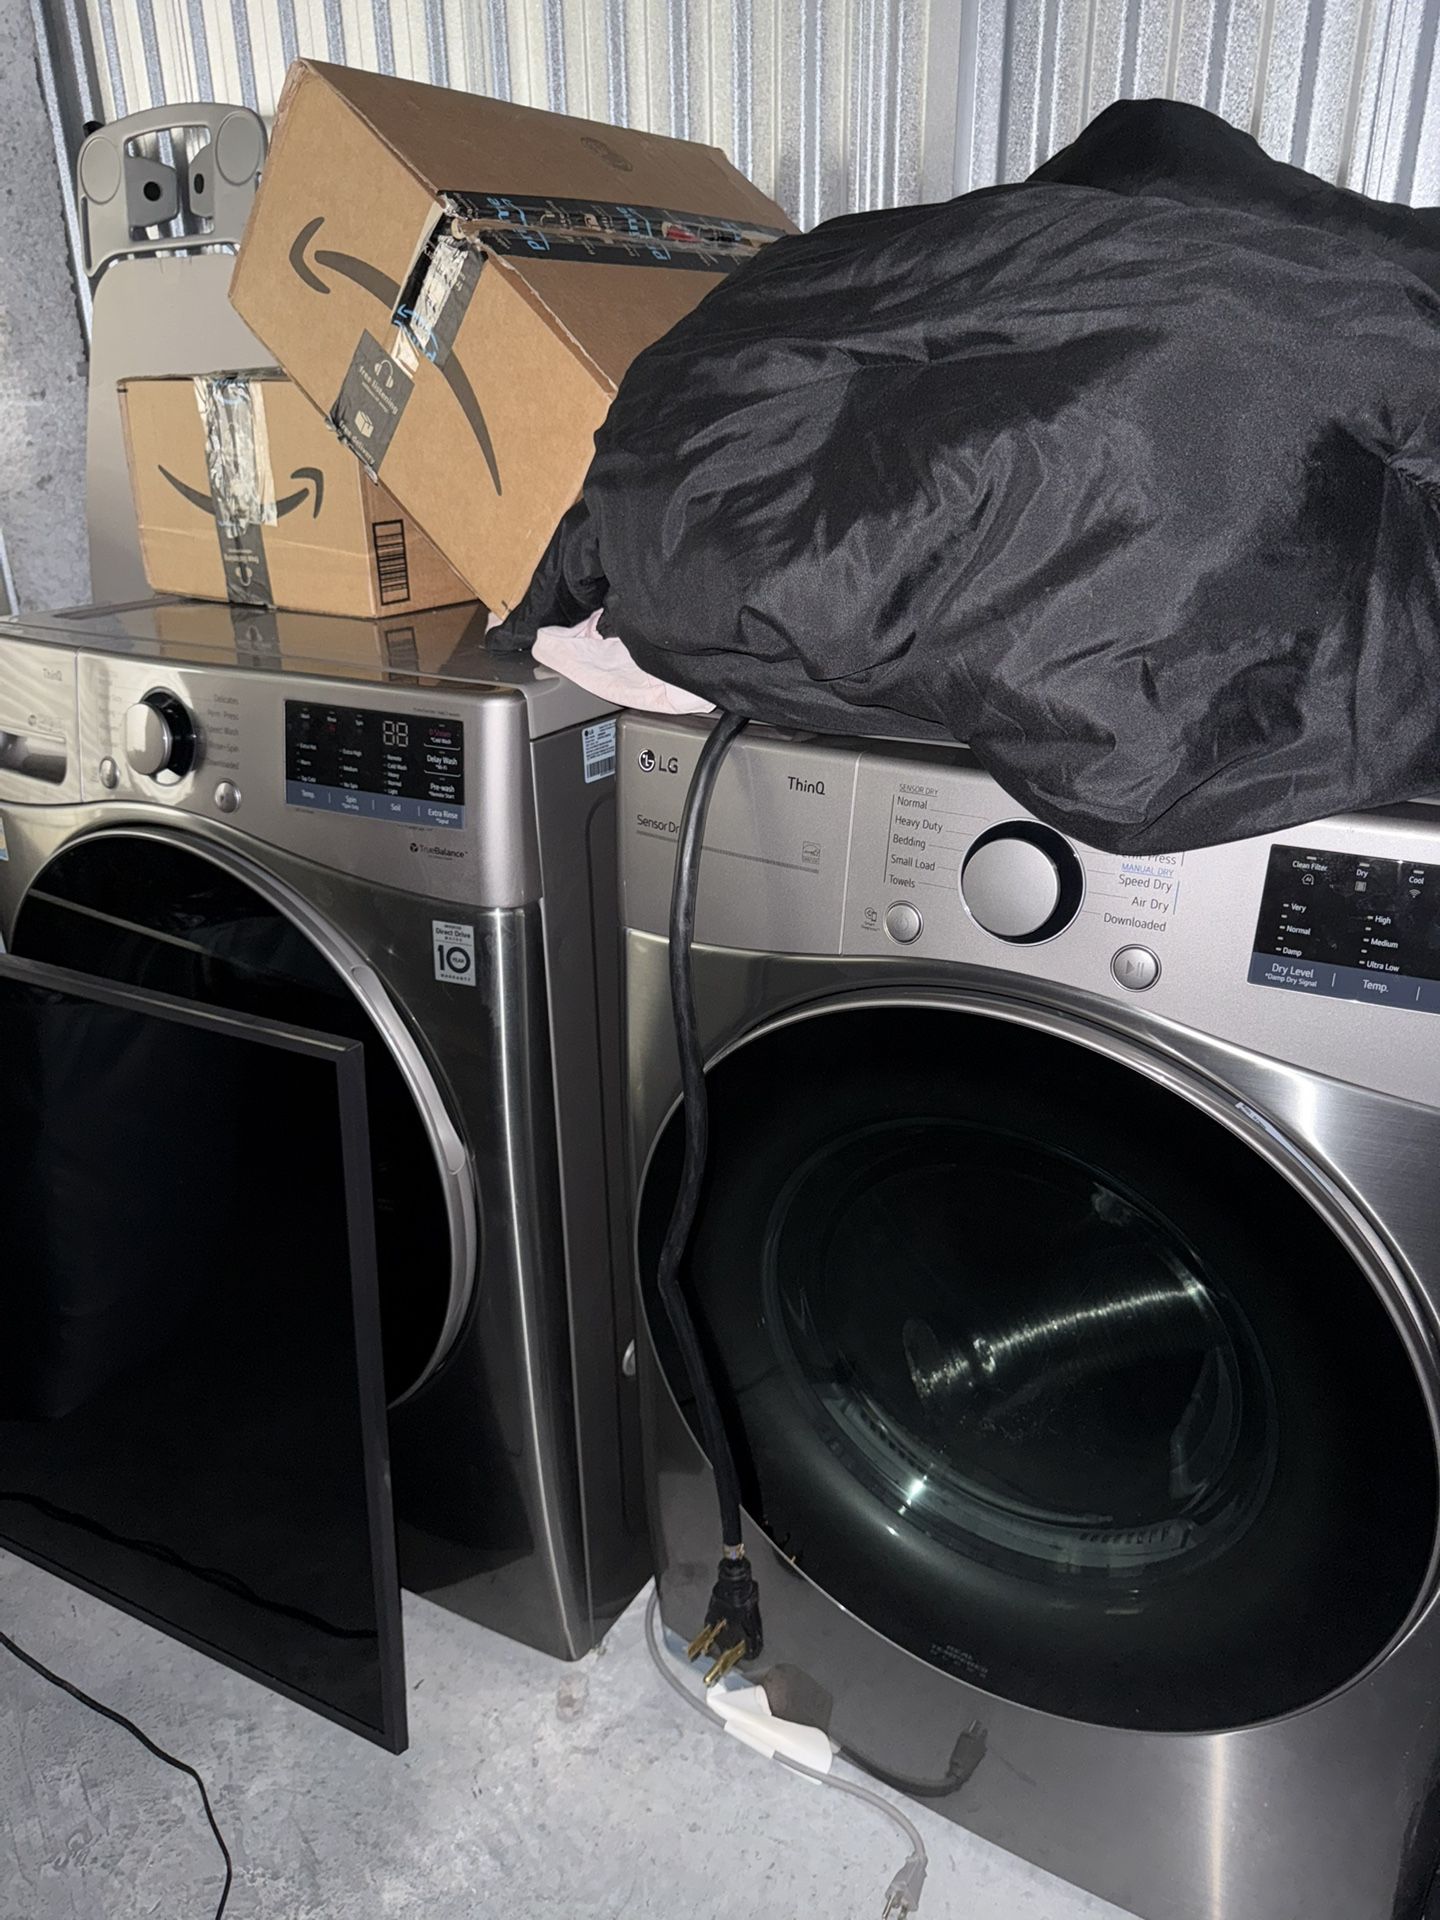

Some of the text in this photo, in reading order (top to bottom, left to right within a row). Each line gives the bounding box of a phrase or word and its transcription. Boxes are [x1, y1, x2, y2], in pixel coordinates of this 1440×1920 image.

[358, 365, 373, 383] free
[371, 379, 399, 416] listening
[426, 754, 458, 766] Delay Wash
[659, 757, 679, 774] LG
[429, 782, 455, 793] Pre-wash
[788, 776, 826, 796] ThinQ
[899, 783, 938, 796] SENSOR DRY
[345, 794, 358, 804] Spin
[896, 796, 928, 810] Normal
[390, 802, 401, 812] Soil
[427, 808, 459, 820] Extra Rinse
[636, 813, 680, 834] Sensor Dr
[895, 815, 943, 833] Heavy Duty
[892, 833, 926, 851] Bedding
[890, 853, 936, 872] Small Load
[1292, 860, 1328, 872] Clean Filter
[1121, 863, 1175, 878] MANUAL DRY
[1356, 868, 1369, 879] Dry
[889, 874, 916, 888] Towels
[1118, 873, 1173, 894] Speed Dry
[1408, 876, 1425, 886] Cool
[1131, 896, 1169, 914] Air Dry
[1291, 902, 1307, 914] Very
[1103, 912, 1167, 932] Downloaded
[1374, 915, 1392, 926] High
[436, 927, 454, 937] Direct
[454, 930, 471, 939] Drive
[1286, 925, 1312, 936] Normal
[1370, 938, 1399, 949] Medium
[437, 944, 472, 974] 10
[1282, 947, 1303, 958] Damp
[1271, 963, 1315, 979] Dry Level
[1366, 960, 1400, 973] Ultra Low
[1286, 976, 1298, 986] Dry
[1298, 978, 1318, 988] Signal
[1362, 979, 1389, 994] Temp.
